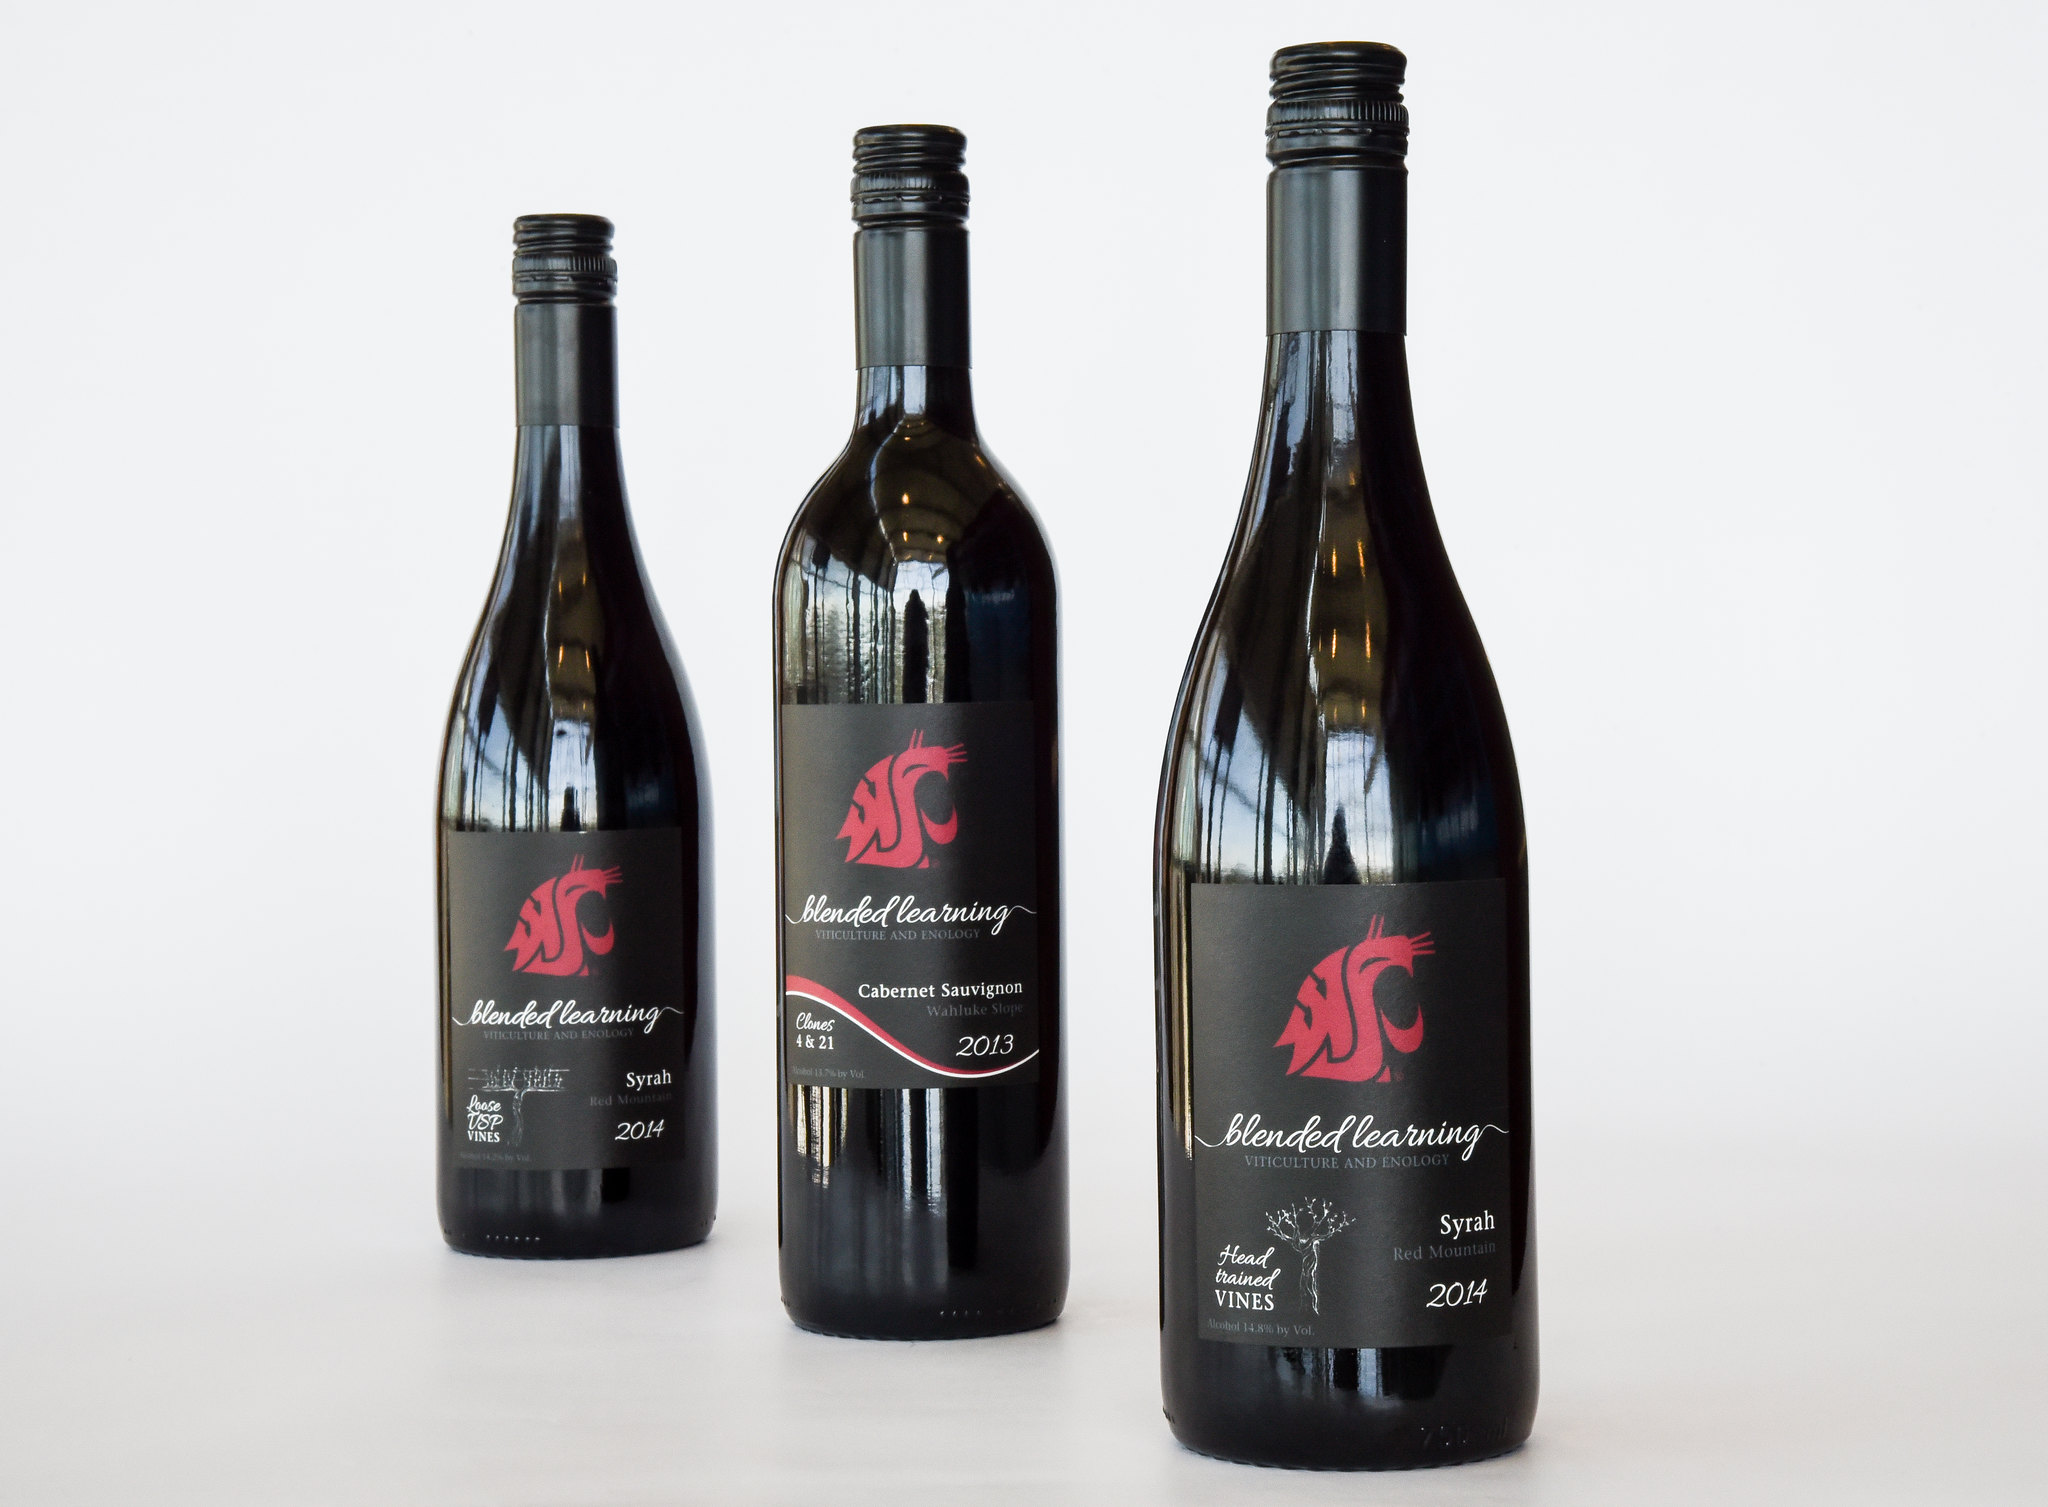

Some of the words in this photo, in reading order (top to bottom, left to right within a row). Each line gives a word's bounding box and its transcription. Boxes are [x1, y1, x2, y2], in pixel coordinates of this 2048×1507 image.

[785, 894, 899, 928] blended
[896, 895, 1037, 936] learning
[815, 929, 886, 941] VITICULTURE
[890, 930, 917, 941] AND
[921, 928, 980, 940] ENOLOGY
[858, 983, 935, 998] Cabernet
[941, 981, 1023, 1001] Sauvignon
[452, 999, 557, 1029] blended
[559, 1000, 684, 1034] learning
[926, 1004, 987, 1017] Wahluke
[991, 1003, 1023, 1017] Slope
[796, 1012, 835, 1032] Clones
[484, 1030, 549, 1041] VITICULTURE
[553, 1030, 578, 1040] AND
[582, 1029, 634, 1039] ENOLOGY
[796, 1037, 802, 1048] 4
[805, 1036, 815, 1049] &
[818, 1036, 834, 1049] 21
[956, 1034, 1014, 1056] 2013
[626, 1070, 672, 1091] Syrah
[466, 1094, 501, 1112] Loose
[590, 1095, 612, 1107] Red
[618, 1092, 672, 1105] Mountain
[467, 1130, 500, 1143] VINES
[614, 1120, 665, 1141] 2014
[1195, 1113, 1351, 1153] blended
[1352, 1114, 1509, 1161] learning
[1244, 1155, 1339, 1169] VITICULTURE
[1344, 1156, 1376, 1169] AND
[1382, 1154, 1450, 1168] ENOLOGY
[1440, 1210, 1495, 1239] Syrah
[1217, 1244, 1275, 1269] Head
[1393, 1246, 1422, 1261] Red
[1429, 1242, 1496, 1260] Mountain
[1215, 1268, 1281, 1290] trained
[1215, 1289, 1274, 1311] VINES
[1426, 1278, 1488, 1308] 2014
[1208, 1318, 1240, 1331] Alcohol
[1243, 1321, 1274, 1334] 14.8%
[1277, 1323, 1290, 1337] by
[1293, 1325, 1315, 1336] Vol.
